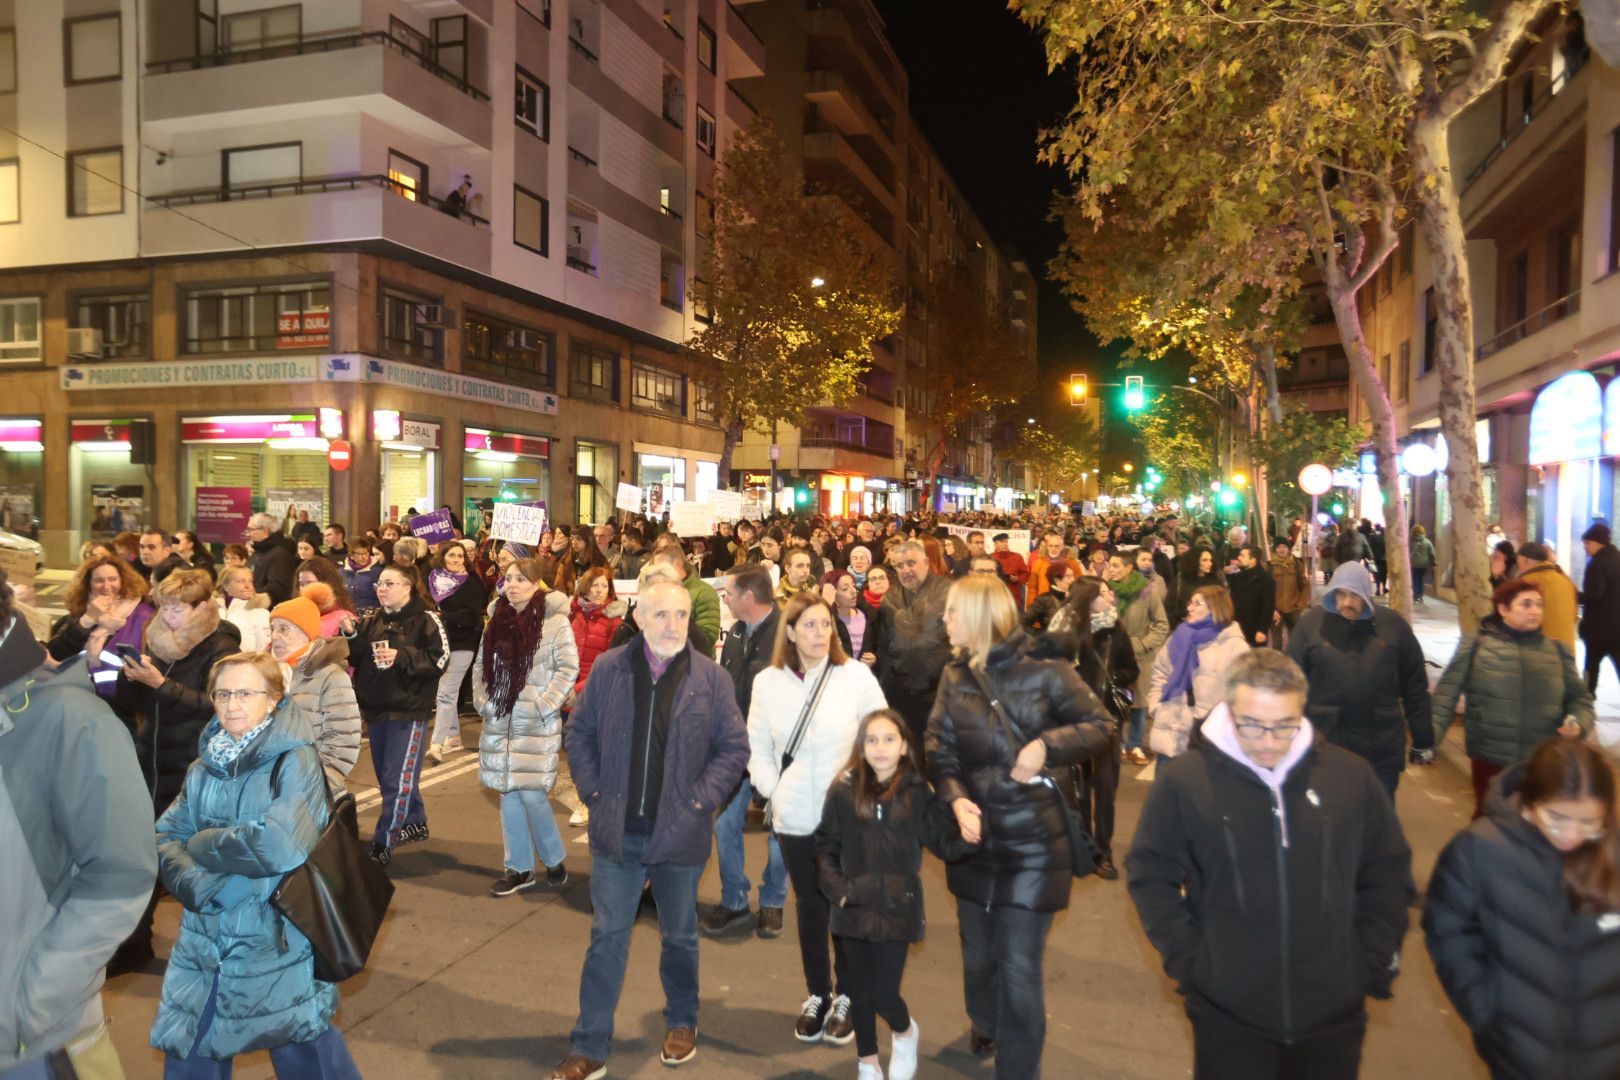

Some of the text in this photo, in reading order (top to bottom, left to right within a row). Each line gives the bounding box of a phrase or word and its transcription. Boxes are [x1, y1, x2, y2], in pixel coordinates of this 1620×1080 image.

[279, 319, 291, 331] SE
[88, 367, 173, 385] PROMOCIONES
[184, 363, 253, 382] CONTRATAS
[387, 365, 452, 392] PROMOCIONES
[454, 377, 461, 393] Y
[462, 379, 505, 402] CONTRATAS
[495, 504, 541, 521] VIOLENCIA
[492, 520, 539, 541] DOMESTICA
